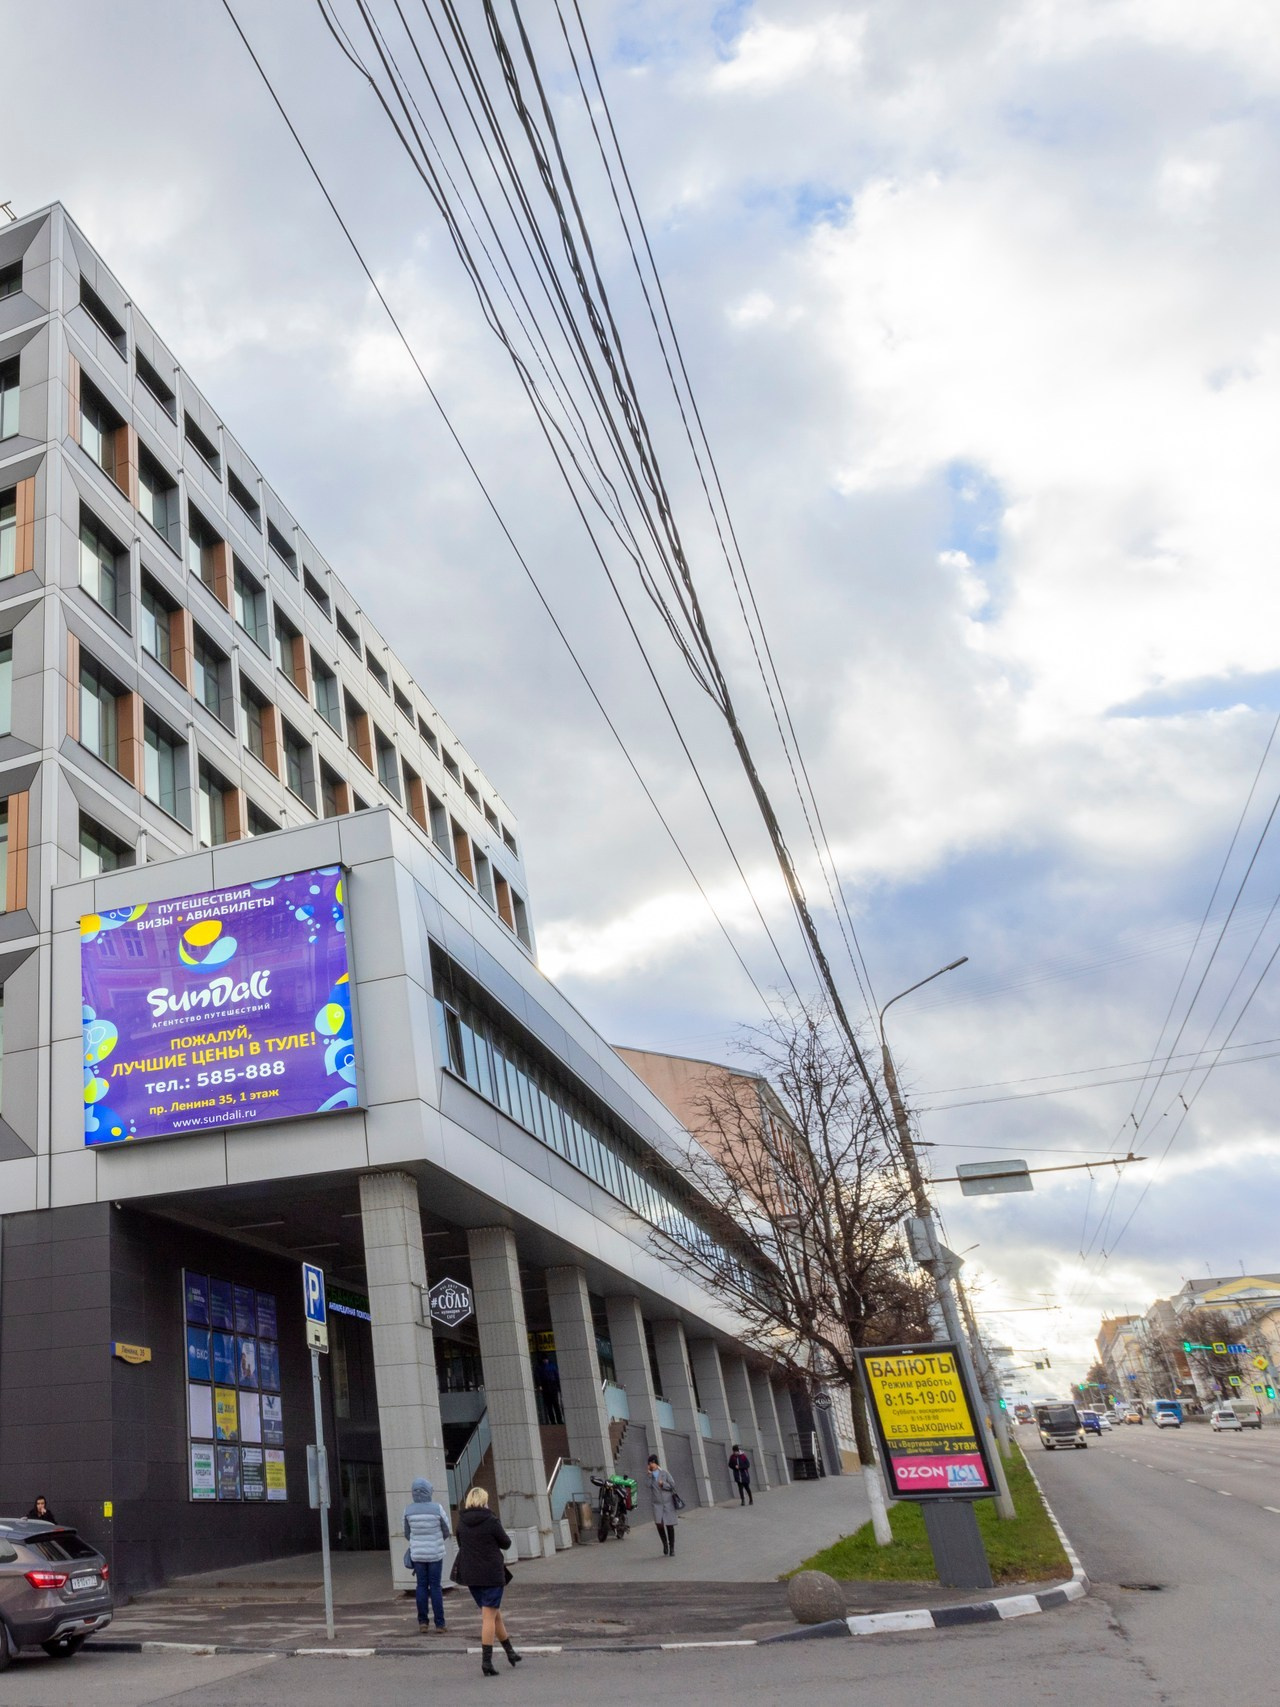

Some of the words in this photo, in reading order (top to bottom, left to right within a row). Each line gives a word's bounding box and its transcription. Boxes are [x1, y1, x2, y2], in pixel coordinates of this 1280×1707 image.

[158, 889, 251, 914] ПУТЕШЕСТВИЯ
[136, 916, 173, 931] ВИЗЫ
[186, 897, 275, 922] АВИАБИЛЕТЫ
[146, 970, 272, 1017] SunDali
[152, 1014, 202, 1028] АГЕНТСТВО
[204, 1003, 270, 1019] ПУТЕШЕСТВИЙ
[170, 1025, 253, 1050] ПОЖАЛУЙ,
[111, 1052, 187, 1077] ЛУЧШИЕ
[192, 1045, 244, 1066] ЦЕНЫ
[250, 1042, 261, 1055] В
[264, 1032, 317, 1053] ТУЛЕ!
[145, 1076, 191, 1094] тел.:
[197, 1060, 286, 1087] 585-888
[149, 1103, 167, 1115] пр.
[171, 1097, 216, 1112] Ленина
[218, 1093, 237, 1107] 35,
[240, 1092, 247, 1102] 1
[250, 1087, 280, 1102] этаж
[172, 1108, 257, 1128] www.sundali.ru
[431, 1293, 469, 1310] #СОЛЬ
[870, 1356, 957, 1378] ВАЛЮТЫ
[881, 1380, 914, 1390] Режим
[916, 1378, 952, 1390] работы
[884, 1390, 957, 1407] 8:15-19:00
[891, 1425, 909, 1434] БЕЗ
[911, 1422, 965, 1433] ВЫХОДНЫХ
[944, 1440, 951, 1451] 2
[953, 1441, 978, 1451] этаж
[897, 1466, 945, 1478] OZON
